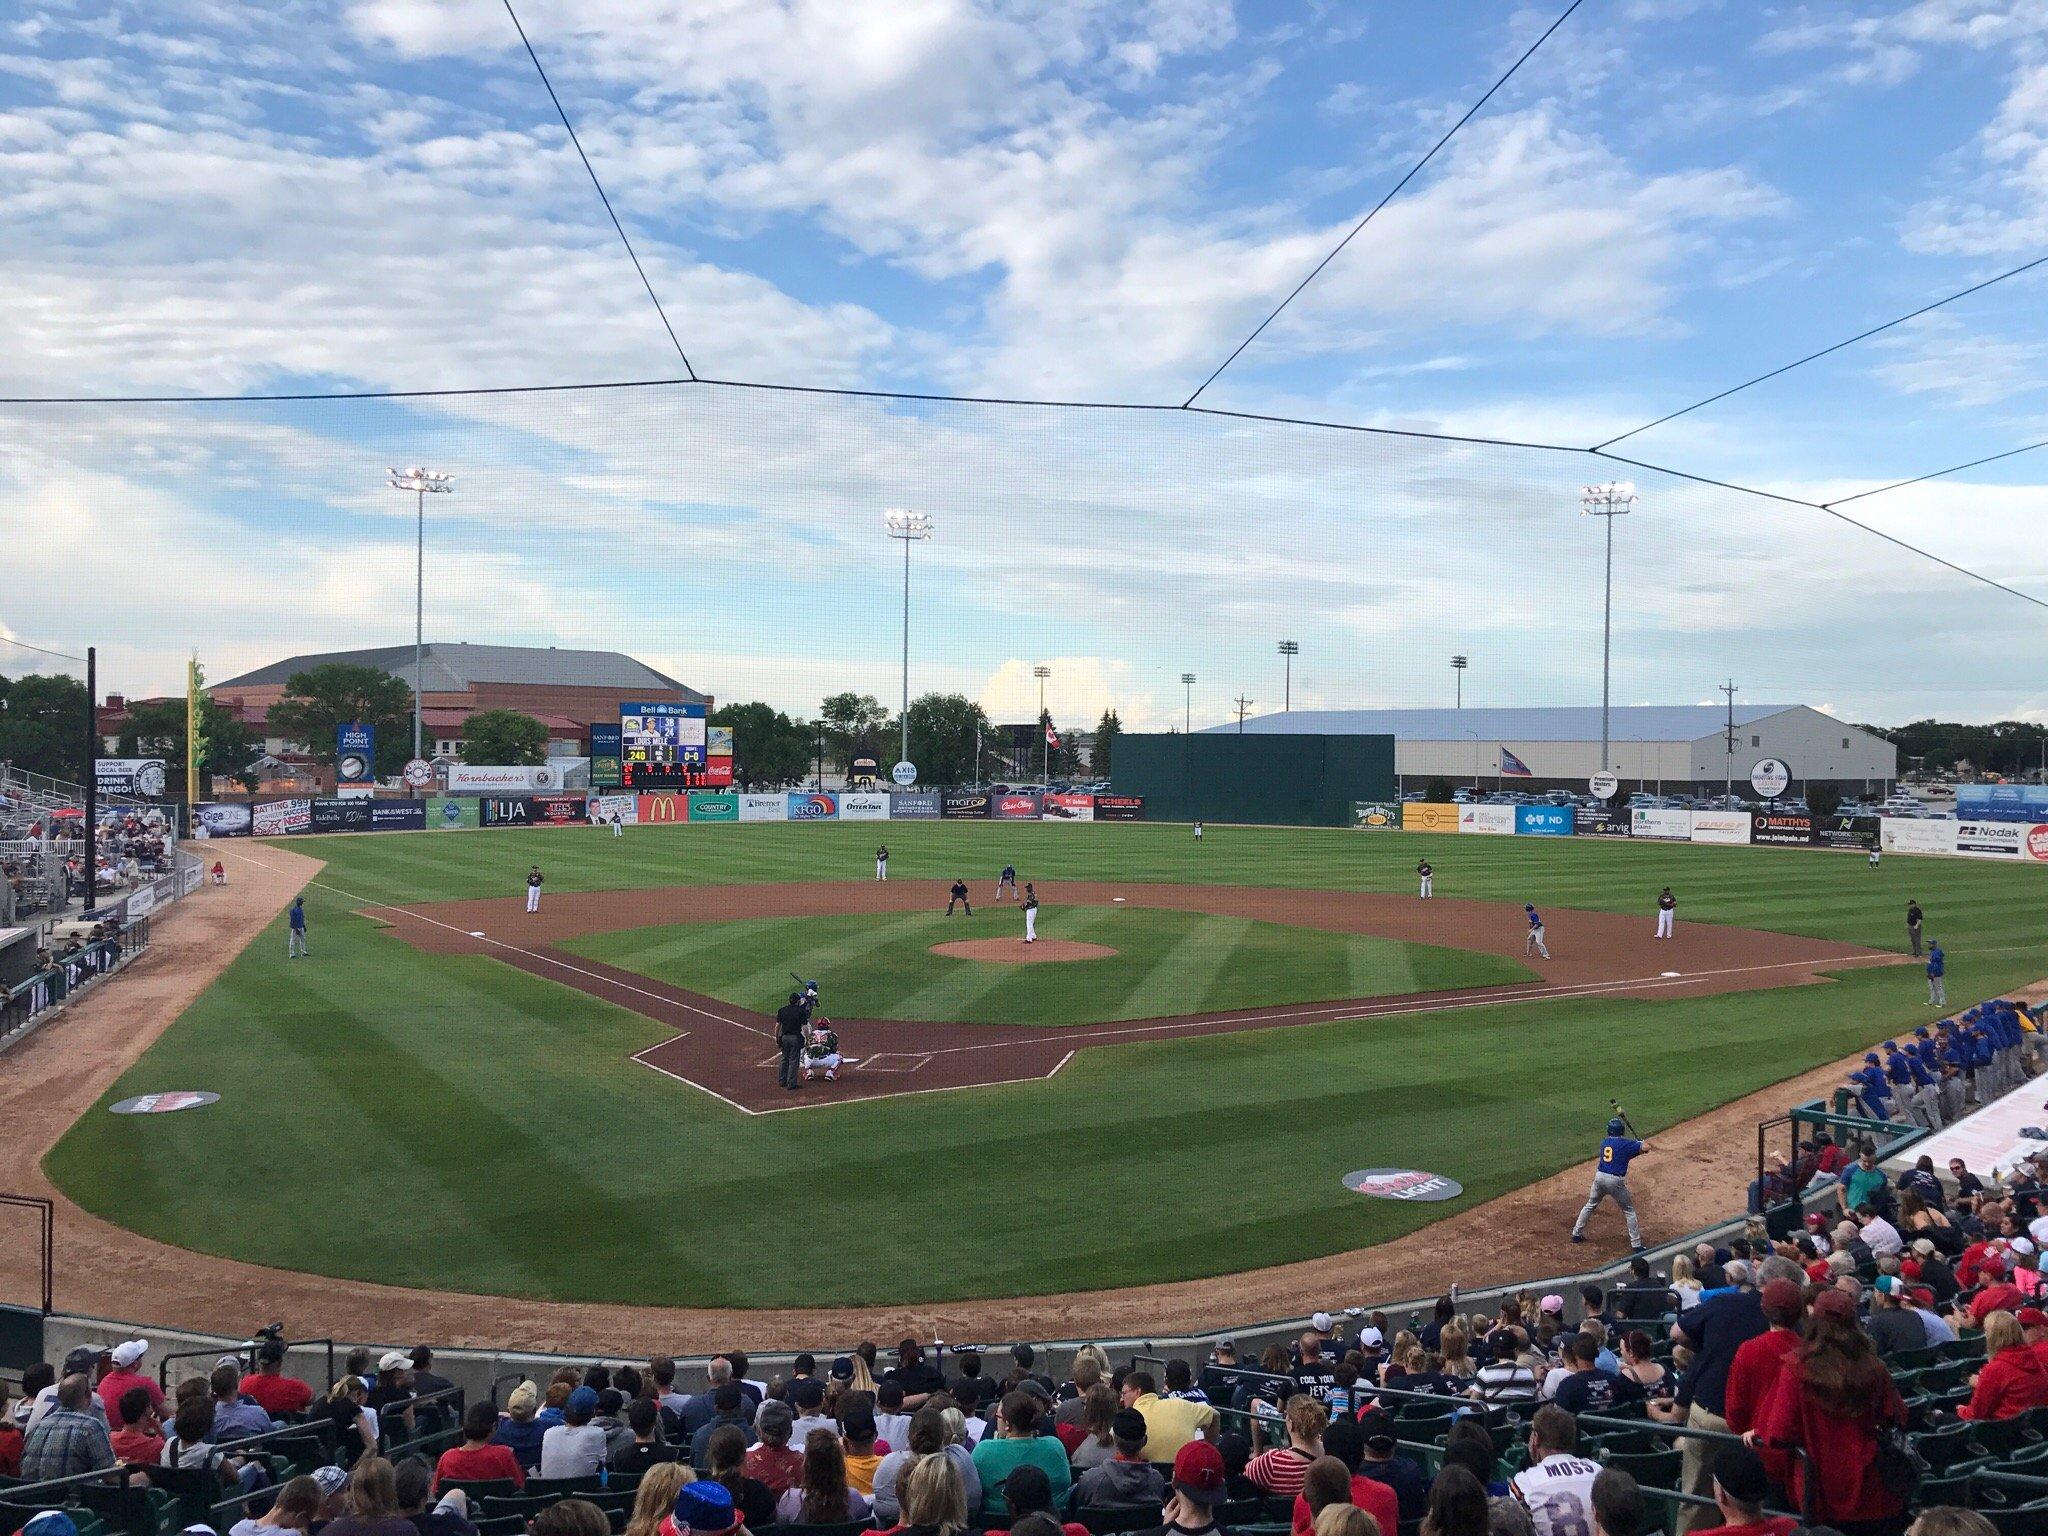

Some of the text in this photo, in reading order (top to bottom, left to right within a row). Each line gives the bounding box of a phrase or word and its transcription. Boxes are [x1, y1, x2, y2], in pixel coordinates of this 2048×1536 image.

[640, 706, 688, 715] Bell Bank
[665, 718, 675, 727] 3B
[664, 728, 675, 737] 24
[634, 737, 668, 745] LOUIS MELE
[684, 751, 699, 761] 0-0
[97, 777, 127, 785] DRINK
[97, 785, 132, 793] FARGO!
[253, 800, 308, 814] BATTING .999
[755, 799, 780, 807] Bremer
[1017, 800, 1033, 809] Clay
[500, 801, 526, 821] LJA
[793, 805, 821, 814] KFGO
[1549, 816, 1563, 824] ND
[1768, 817, 1811, 827] MATTHYS
[1606, 822, 1630, 835] arvig
[1979, 826, 2020, 838] Nodak
[1602, 1146, 1613, 1163] 9
[1391, 1178, 1448, 1199] LIGHT
[1300, 1375, 1335, 1384] COOL YOUR
[1309, 1385, 1331, 1397] JETS
[1544, 1461, 1595, 1478] MOSS
